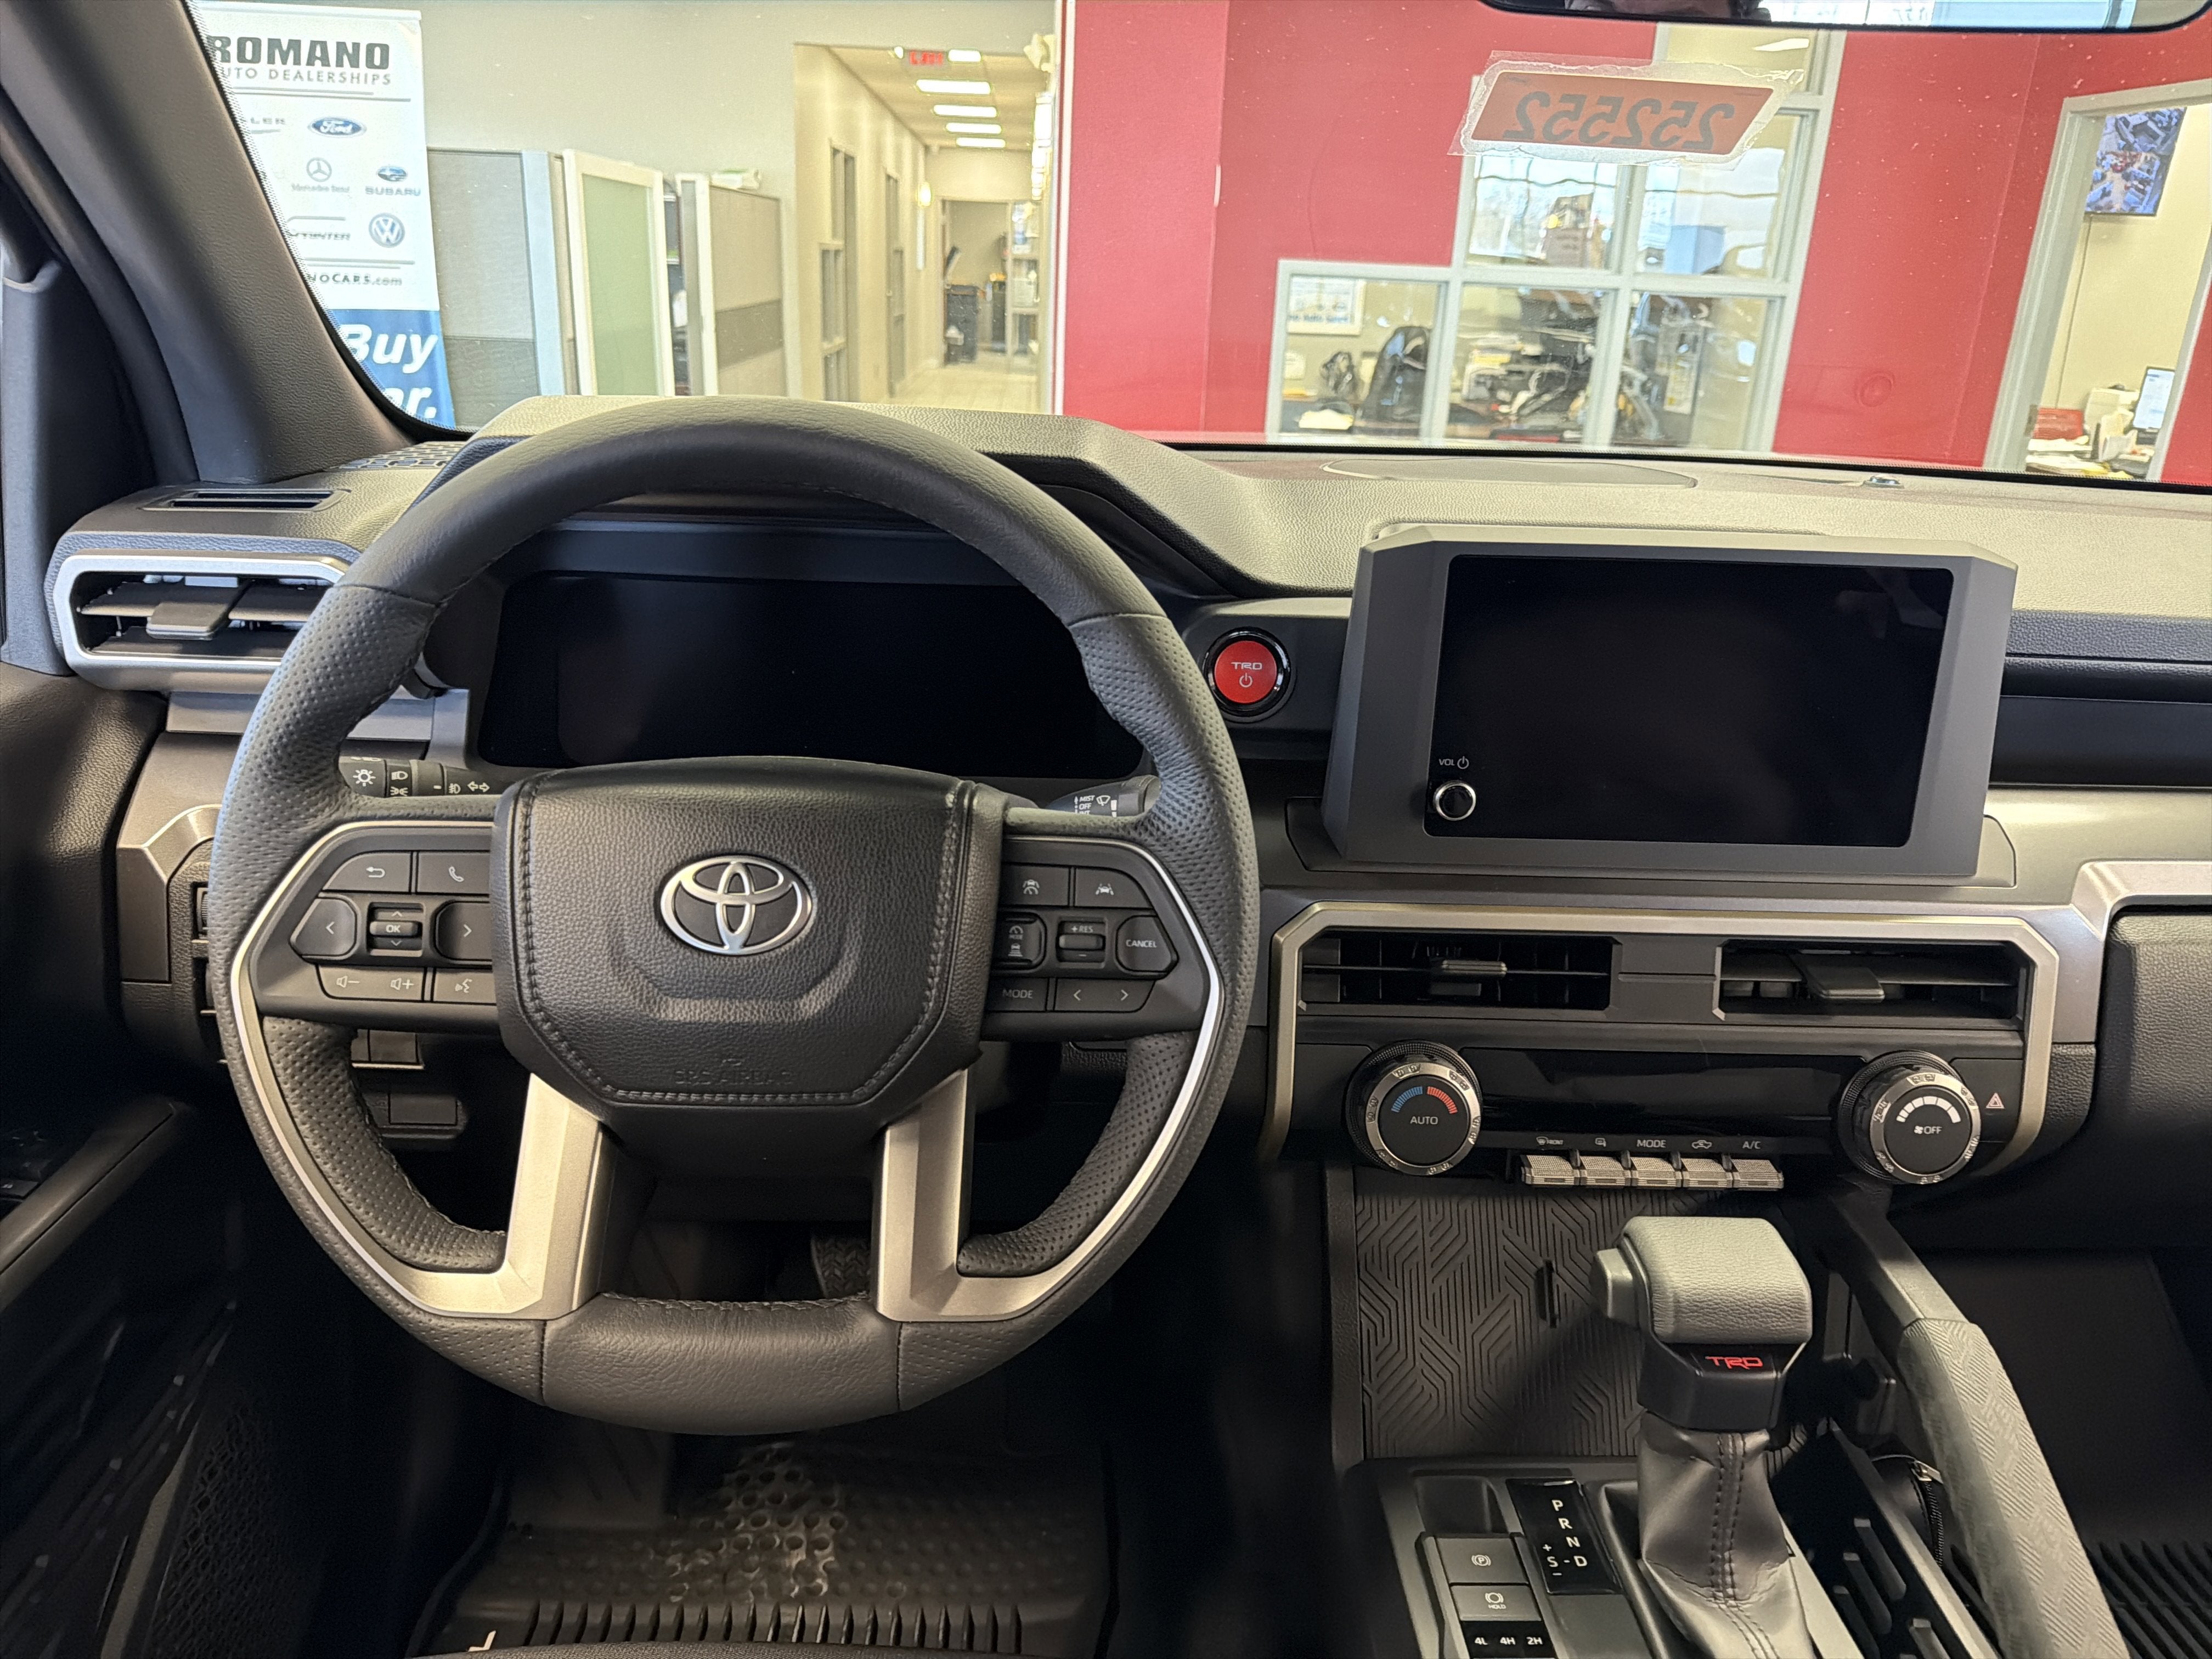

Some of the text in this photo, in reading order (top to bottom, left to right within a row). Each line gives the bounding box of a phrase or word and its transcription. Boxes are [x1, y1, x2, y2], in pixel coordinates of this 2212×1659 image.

[207, 36, 390, 70] ROMANO
[268, 68, 392, 86] DEALERSHIPS
[365, 186, 421, 196] SUBARU
[339, 324, 438, 374] Buy
[1231, 662, 1262, 670] TRD
[386, 924, 400, 933] OK
[1125, 939, 1157, 948] CANCEL
[1002, 989, 1033, 998] MODE
[1409, 1116, 1438, 1125] AUTO
[1923, 1126, 1943, 1135] OFF
[1637, 1139, 1667, 1148] MODE
[1742, 1141, 1761, 1149] A/C
[1705, 1356, 1763, 1370] TRD
[1551, 1499, 1564, 1511] P
[1558, 1517, 1573, 1530] R
[1566, 1537, 1581, 1548] N
[1474, 1637, 1543, 1645] 4L 4H 2H
